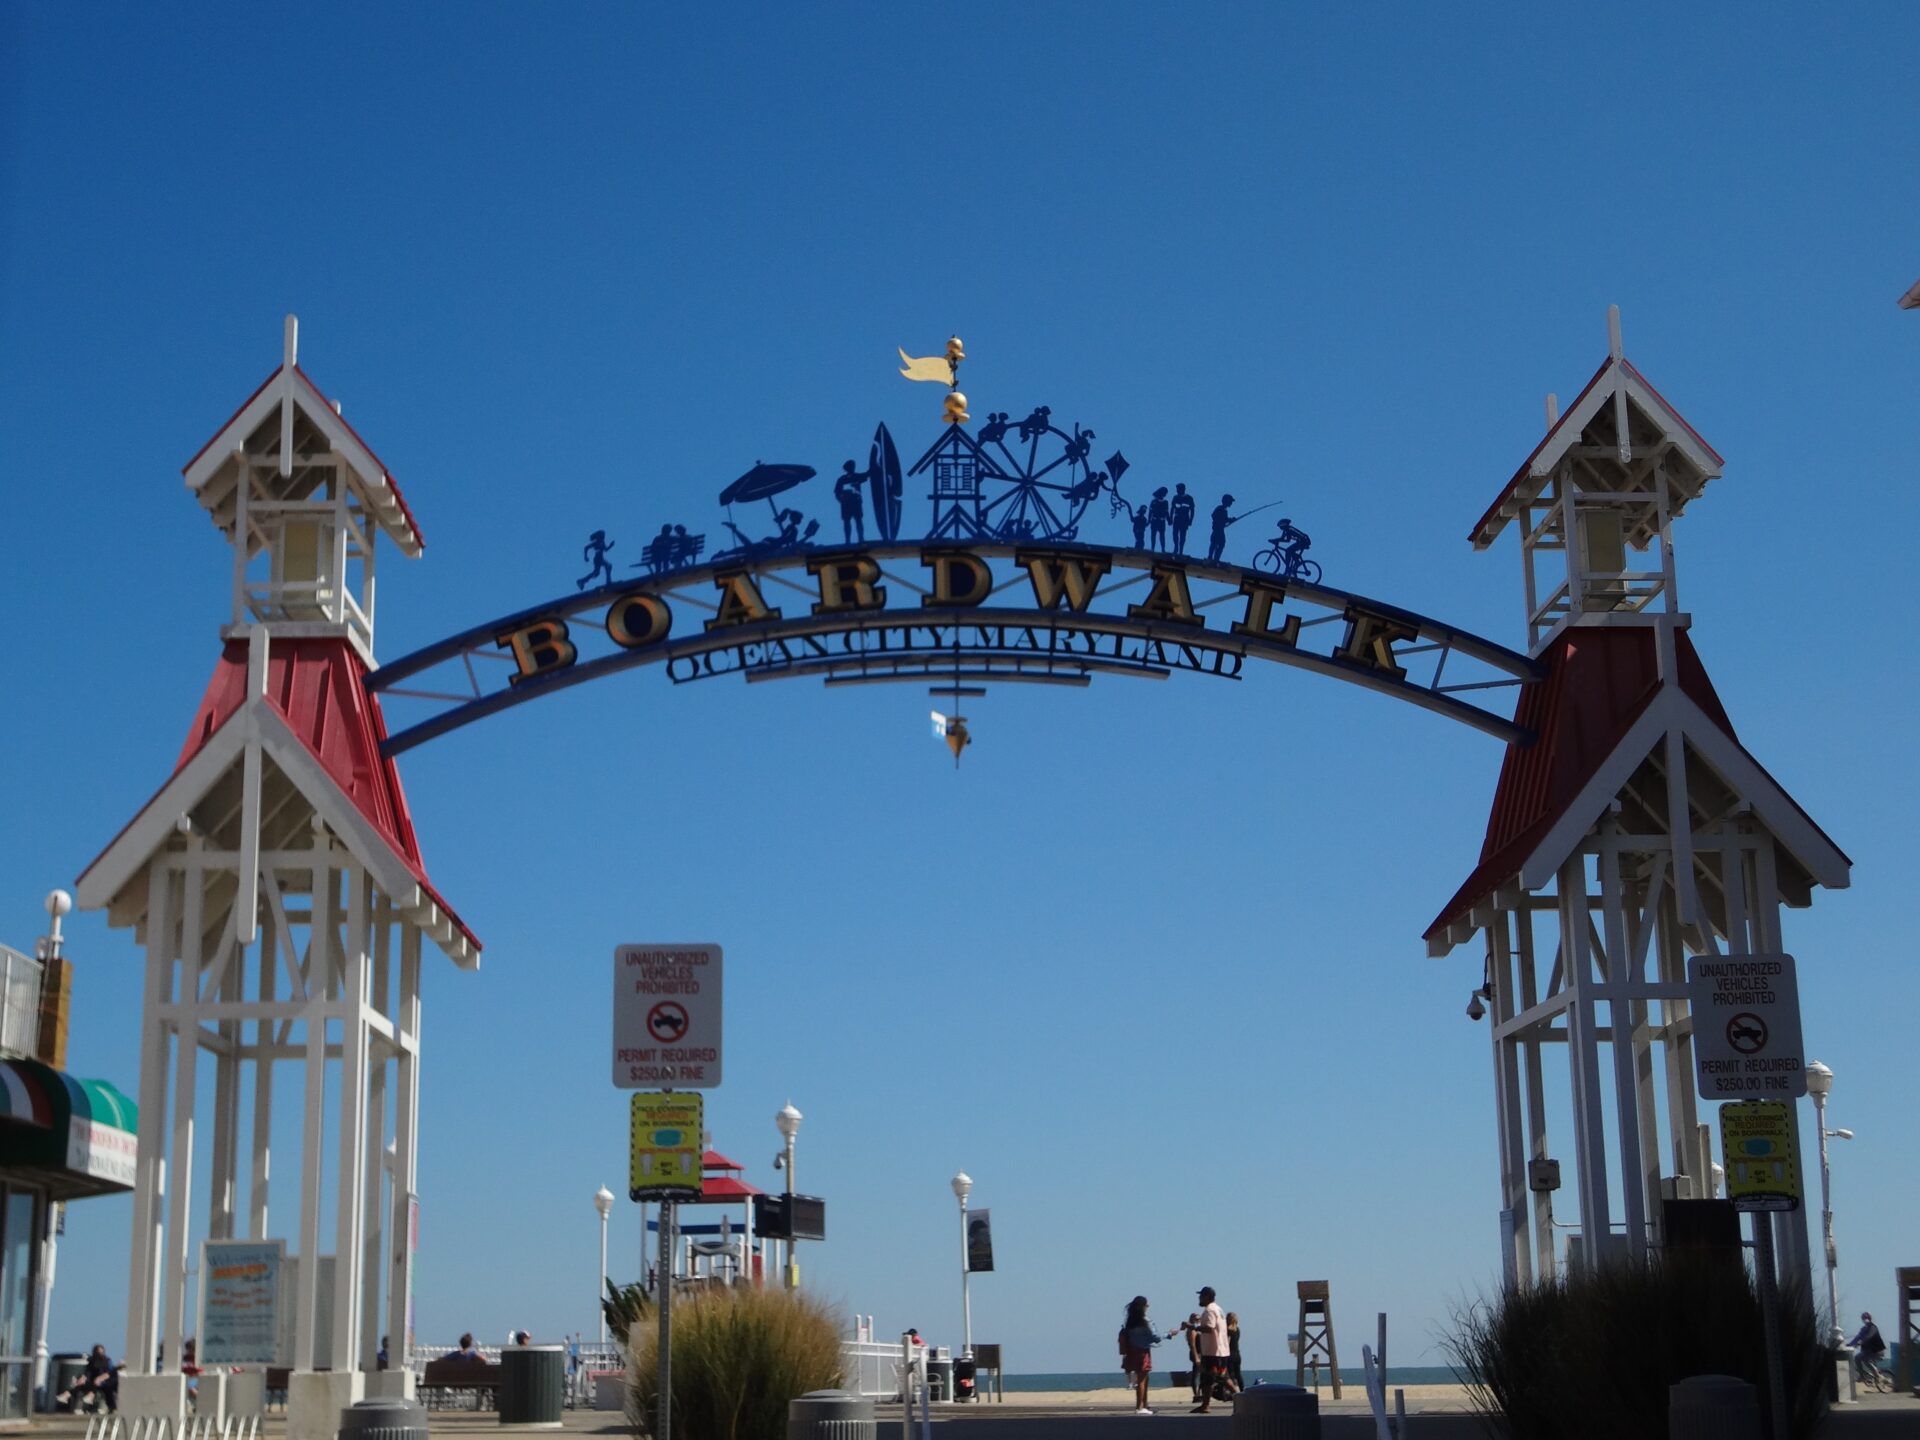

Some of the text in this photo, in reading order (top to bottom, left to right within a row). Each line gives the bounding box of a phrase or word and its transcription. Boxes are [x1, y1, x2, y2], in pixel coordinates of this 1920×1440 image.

[495, 546, 1420, 686] BOARDWALK
[666, 633, 829, 685] OCEAN
[970, 624, 1244, 680] MARYLAND
[625, 951, 709, 966] UNAUTHORIZED
[641, 966, 693, 979] VEHICLES
[1699, 961, 1782, 977] UNAUTHORIZED
[636, 980, 700, 994] PROHIBITED
[1716, 976, 1768, 991] VEHICLES
[1713, 991, 1776, 1005] PROHIBITED
[618, 1048, 717, 1062] PERMIT REQUIRED
[680, 1065, 704, 1080] FINE
[1701, 1058, 1800, 1074] PERMIT REQUIRED
[1716, 1076, 1789, 1091] $250.00 FINE
